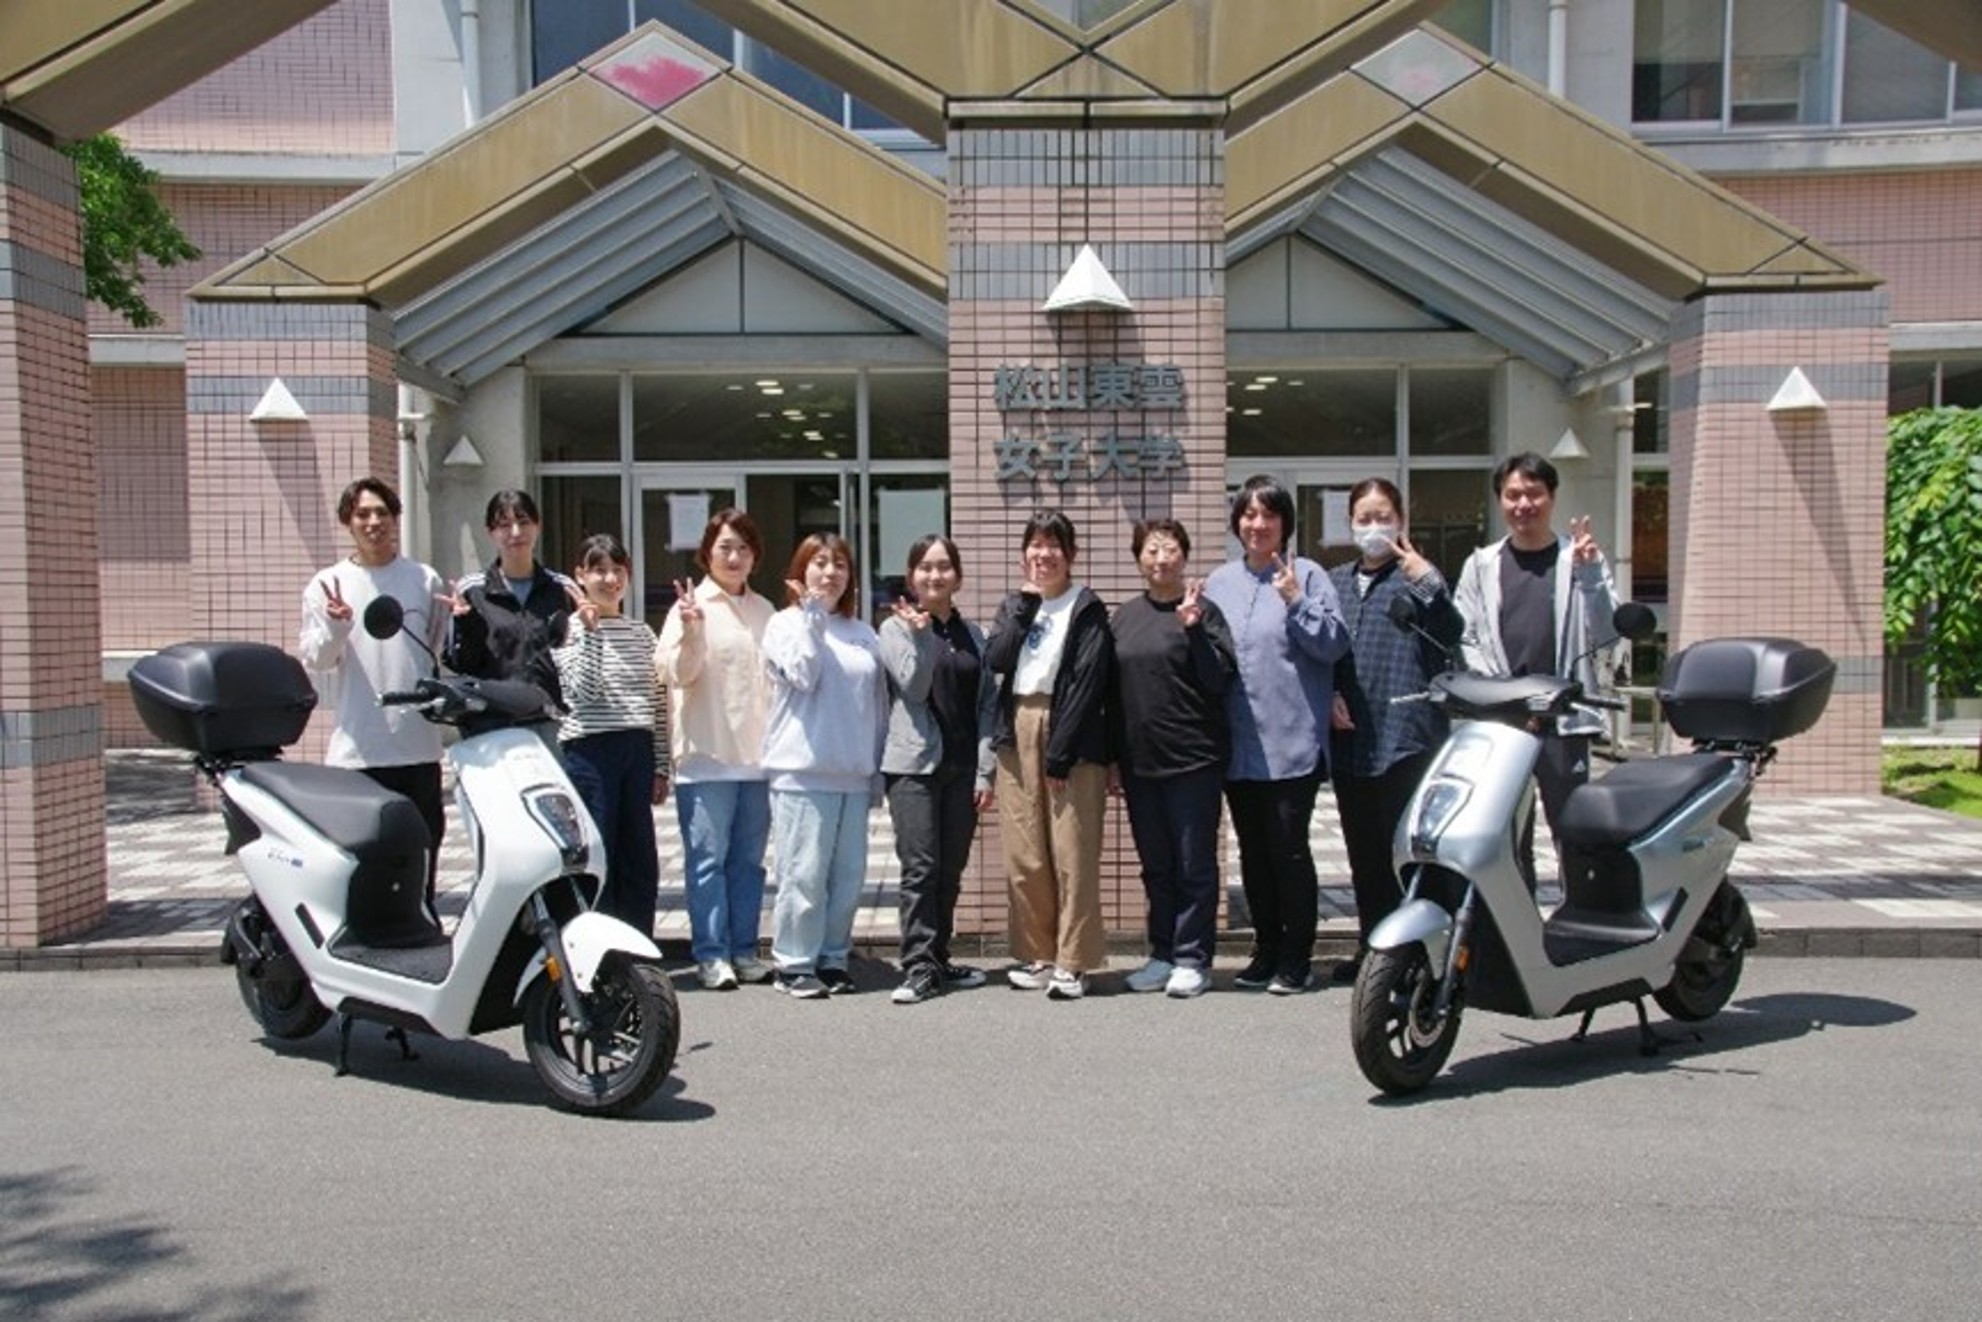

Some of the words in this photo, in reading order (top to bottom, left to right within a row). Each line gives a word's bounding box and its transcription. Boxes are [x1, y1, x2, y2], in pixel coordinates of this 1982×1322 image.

[994, 361, 1184, 409] 松山東雲
[994, 428, 1186, 481] 女子大学
